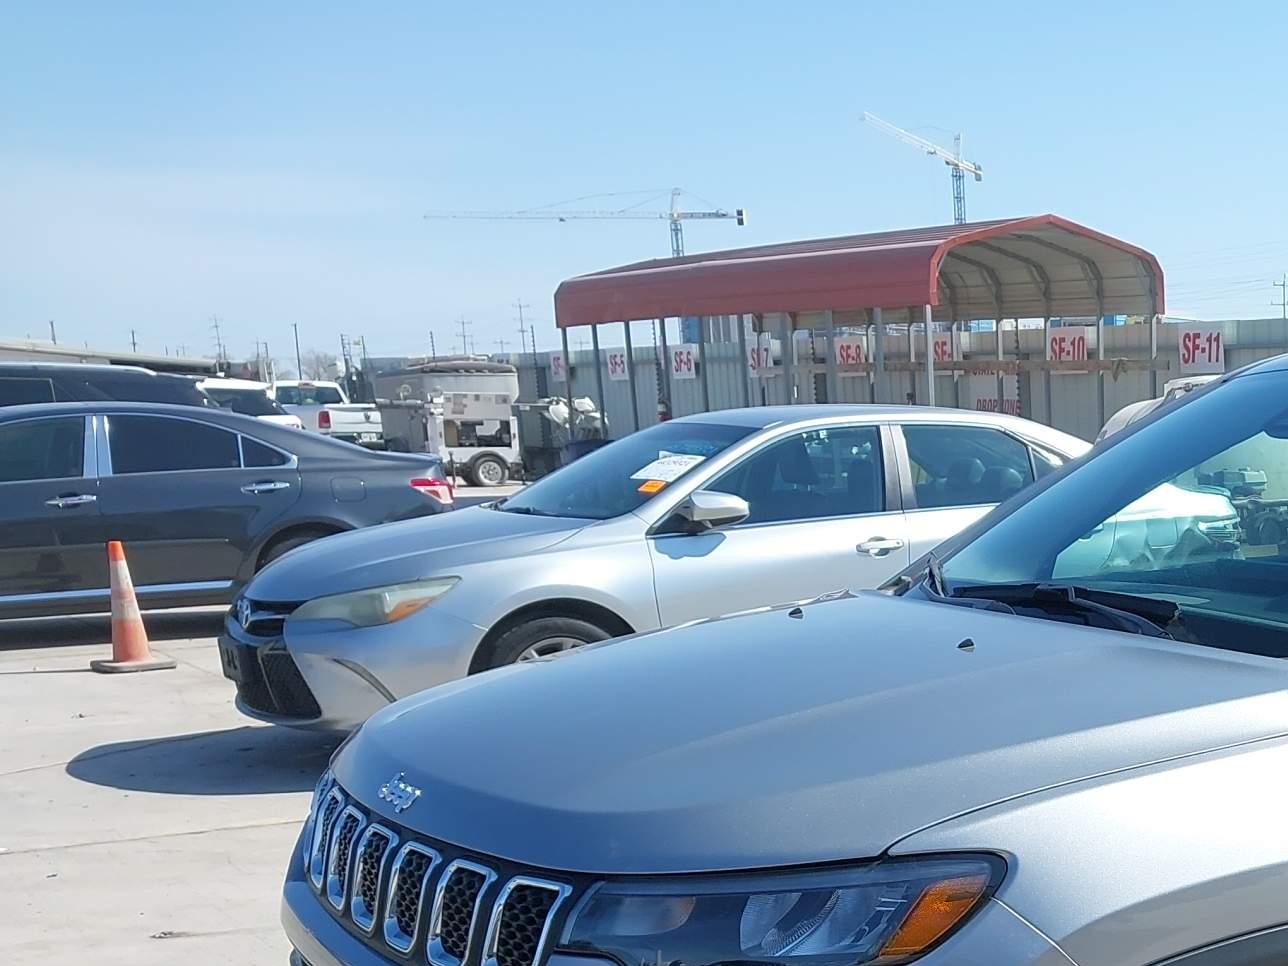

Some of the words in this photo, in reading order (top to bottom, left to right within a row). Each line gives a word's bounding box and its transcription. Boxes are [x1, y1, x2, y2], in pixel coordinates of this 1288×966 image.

[839, 343, 862, 364] SF-8
[934, 341, 959, 361] SF-
[1050, 335, 1087, 361] SF-10
[1182, 332, 1221, 364] SF-11
[609, 353, 625, 375] SF-5
[674, 350, 692, 373] SF-6
